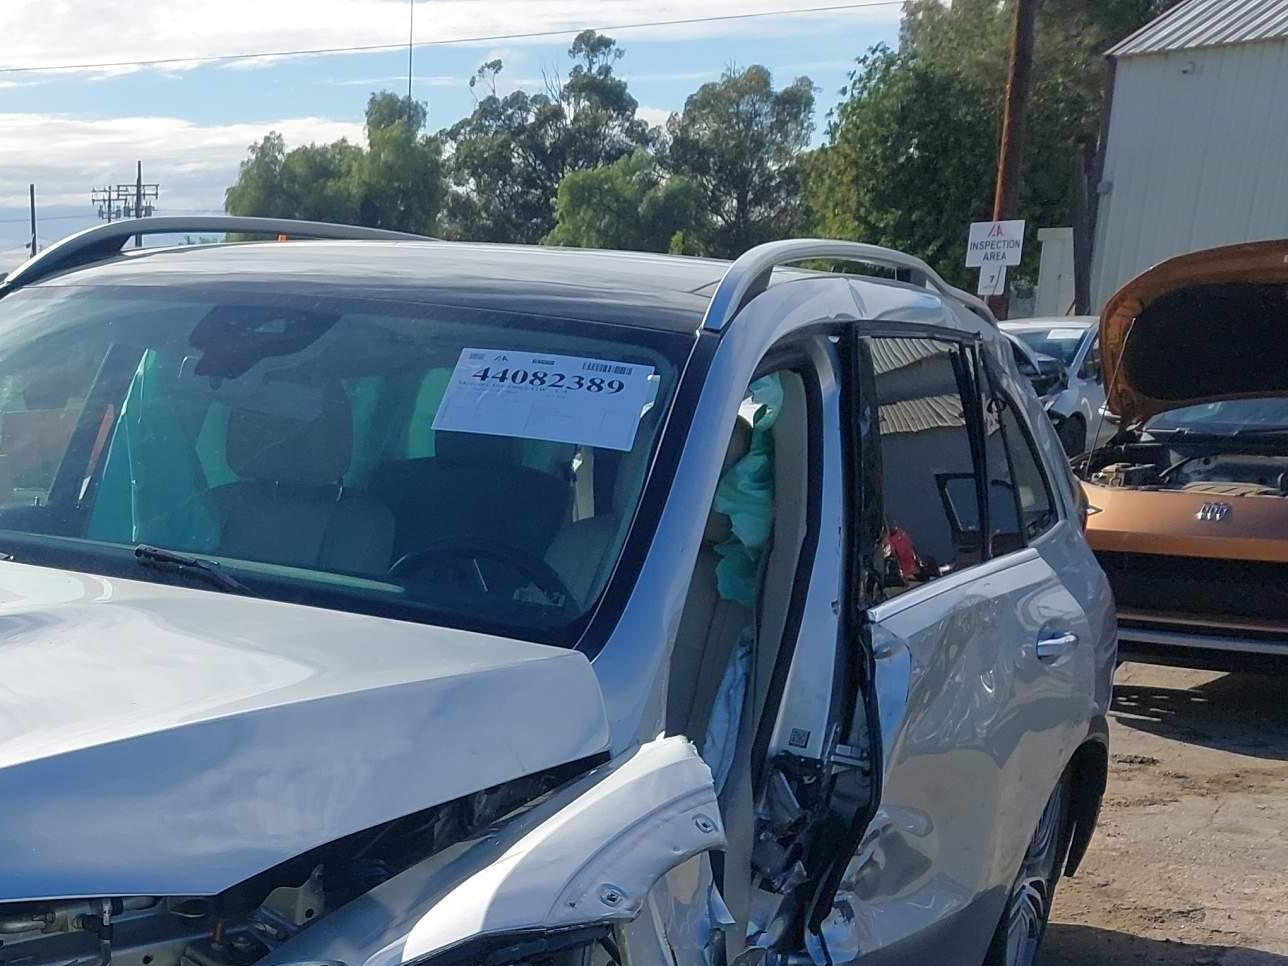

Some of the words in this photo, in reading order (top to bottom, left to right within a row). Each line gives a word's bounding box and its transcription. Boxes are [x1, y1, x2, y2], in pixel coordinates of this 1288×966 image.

[969, 240, 1021, 251] INSPECTION
[982, 252, 1007, 261] AREA
[472, 366, 625, 394] 44082389
